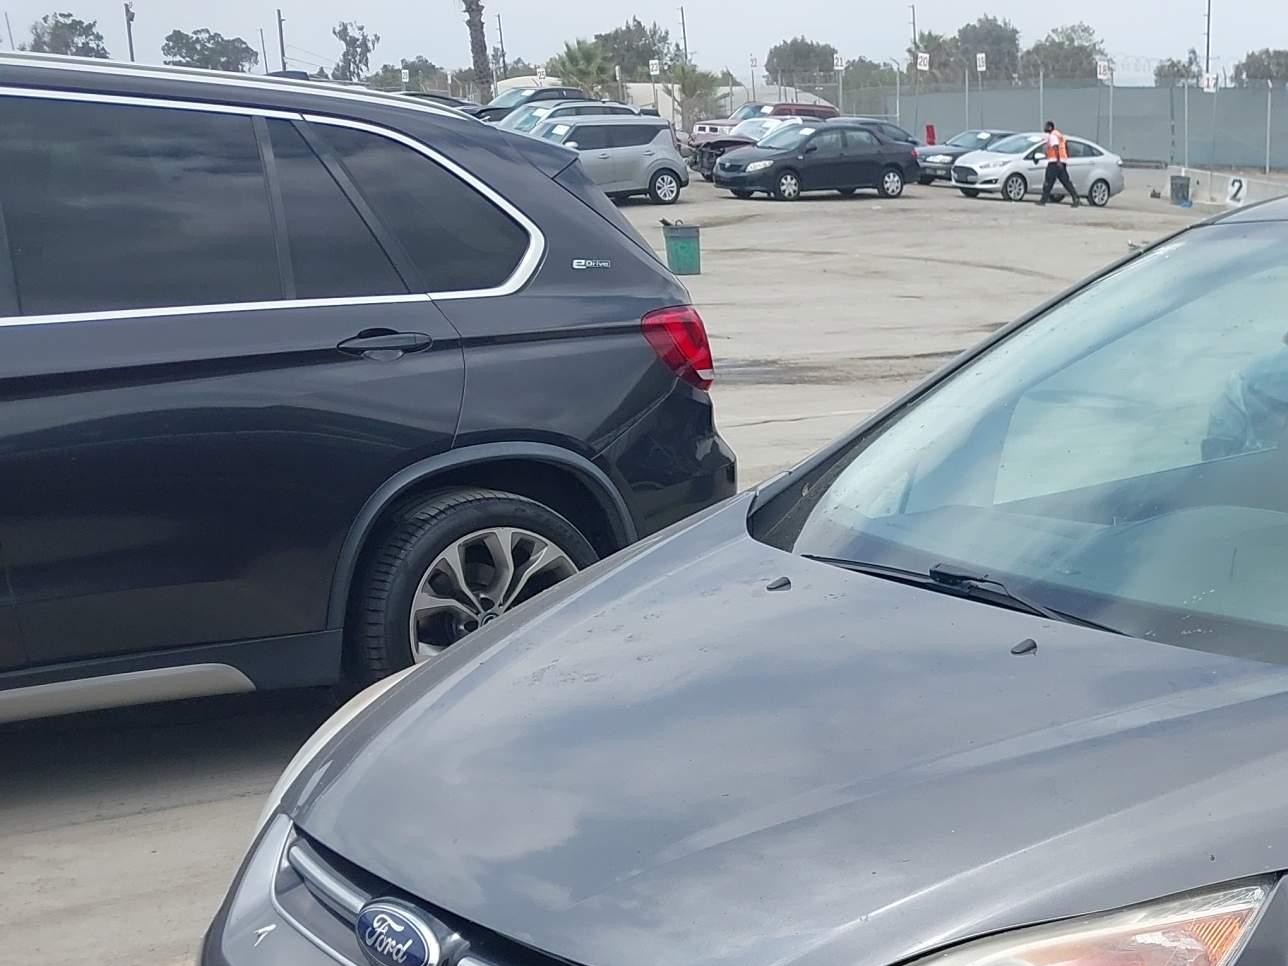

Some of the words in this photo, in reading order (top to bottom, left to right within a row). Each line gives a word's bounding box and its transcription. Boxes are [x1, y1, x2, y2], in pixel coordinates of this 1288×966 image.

[834, 56, 844, 67] 21
[918, 55, 928, 68] 20
[1230, 178, 1243, 202] 2
[365, 913, 414, 964] Ford
